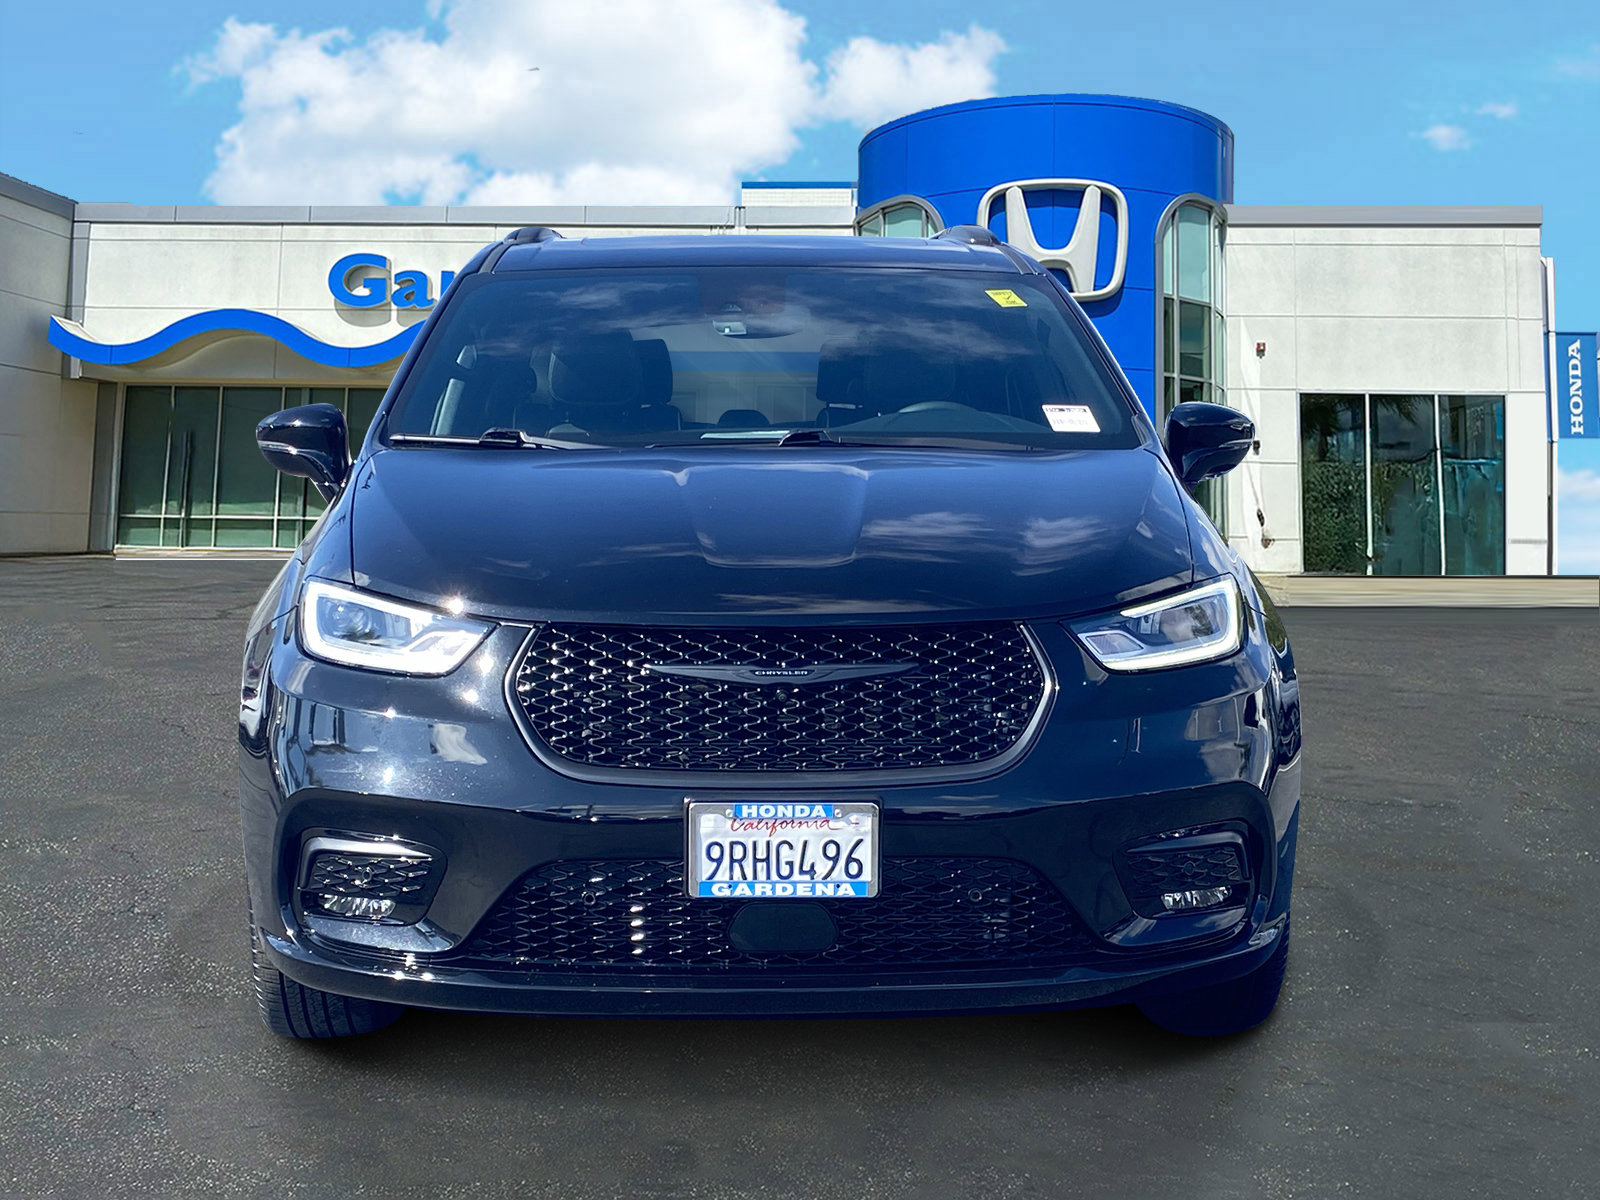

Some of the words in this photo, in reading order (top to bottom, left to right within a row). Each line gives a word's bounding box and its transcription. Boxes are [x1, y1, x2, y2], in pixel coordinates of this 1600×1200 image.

[1567, 339, 1584, 435] HONDA
[741, 804, 827, 818] HONDA
[730, 817, 845, 837] California
[704, 838, 864, 881] 9RHG496
[711, 882, 856, 897] GARDENA
